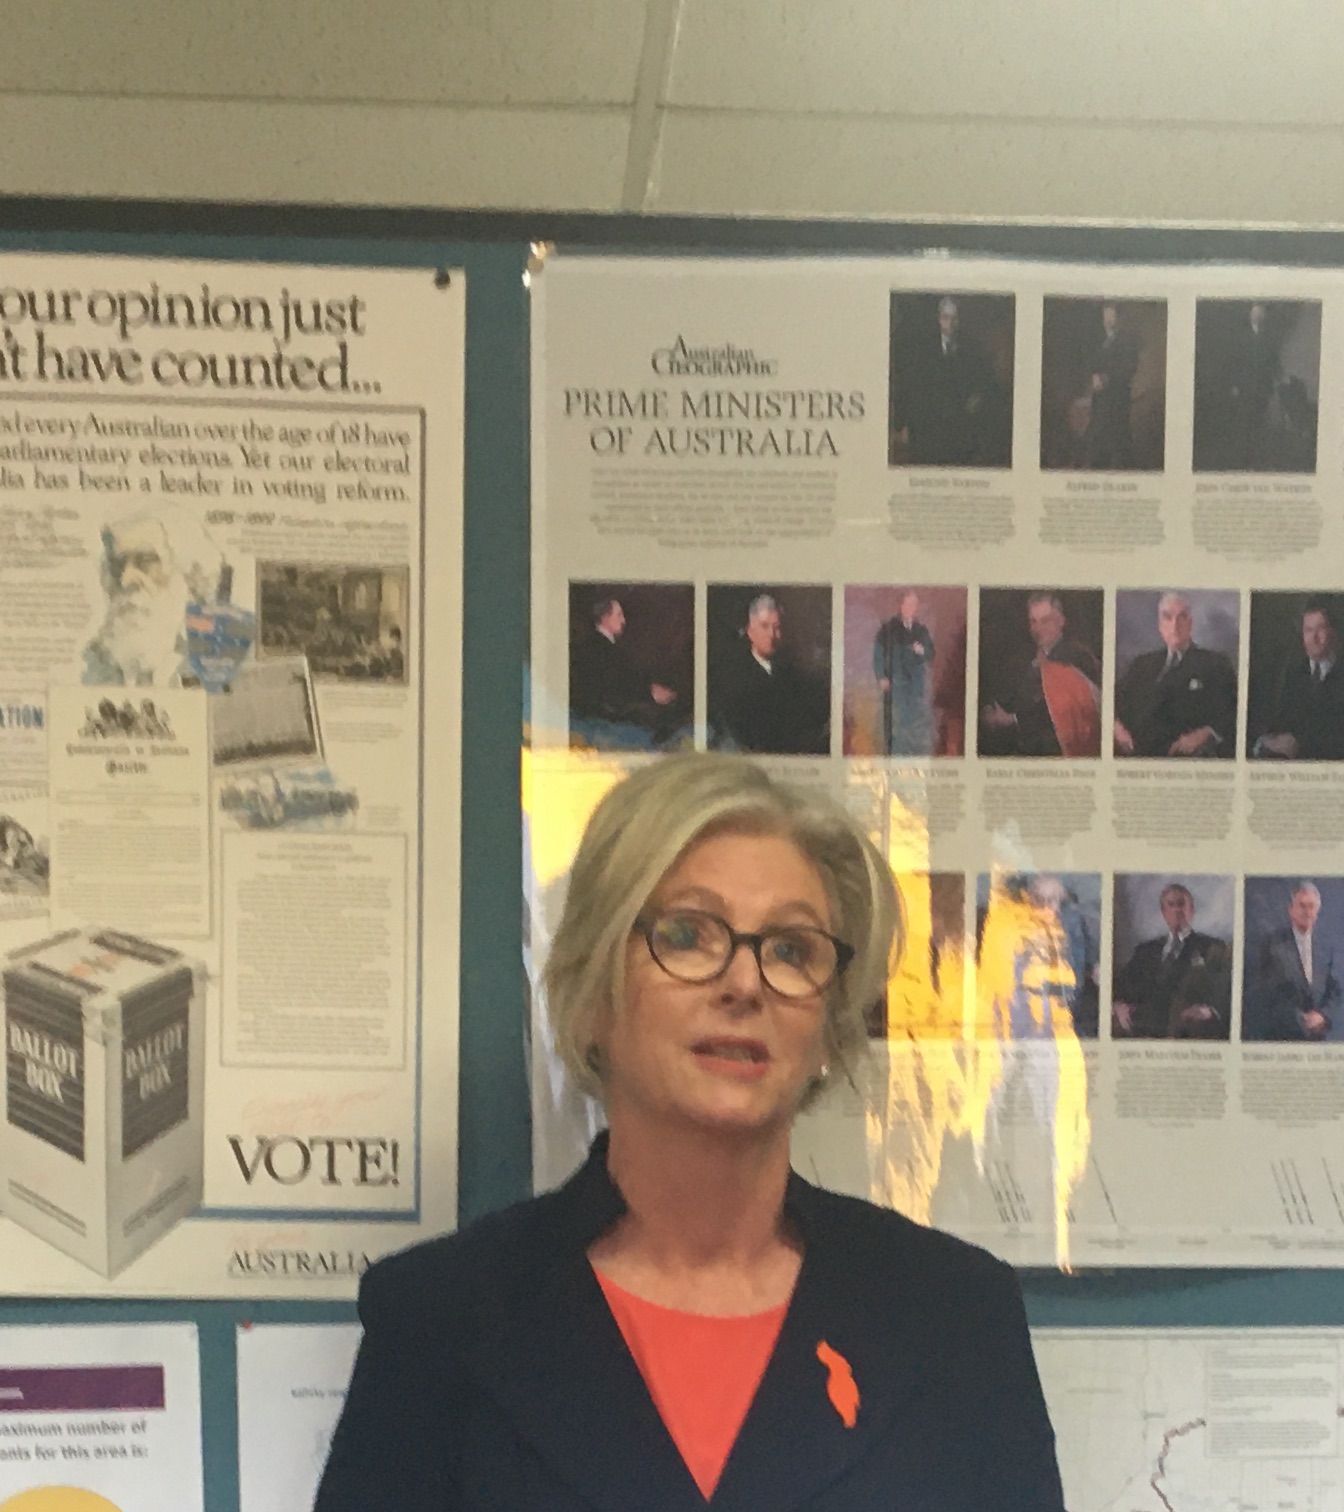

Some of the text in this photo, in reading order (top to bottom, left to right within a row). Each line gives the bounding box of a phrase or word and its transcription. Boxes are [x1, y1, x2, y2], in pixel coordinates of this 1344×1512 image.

[87, 281, 274, 341] opinion
[279, 286, 366, 344] just
[34, 327, 143, 386] have
[151, 337, 382, 394] counted...
[563, 388, 865, 421] PRIME MINISTERS
[24, 416, 81, 440] every
[84, 412, 190, 439] Australian
[194, 424, 238, 441] over
[241, 418, 274, 442] the
[279, 426, 312, 448] age
[316, 420, 341, 444] of
[342, 422, 360, 444] 18
[364, 421, 410, 447] have
[589, 426, 840, 458] OF AUSTRALIA
[239, 444, 271, 470] Yet
[280, 455, 314, 472] our
[324, 449, 410, 476] electoral
[34, 464, 70, 490] has
[78, 466, 130, 493] been
[139, 476, 152, 493] a
[159, 469, 222, 497] leader
[231, 476, 254, 497] in
[261, 477, 327, 503] voting
[9, 1020, 78, 1079] BALLOT
[125, 1023, 184, 1080] BALLOT
[25, 1057, 64, 1103] BOX
[140, 1060, 171, 1101] BOX
[226, 1134, 400, 1187] VOTE!
[227, 1249, 371, 1278] AUSTRALIA
[66, 1419, 126, 1436] number
[130, 1418, 148, 1435] of
[34, 1443, 57, 1460] for
[59, 1444, 91, 1460] this
[93, 1446, 128, 1459] area
